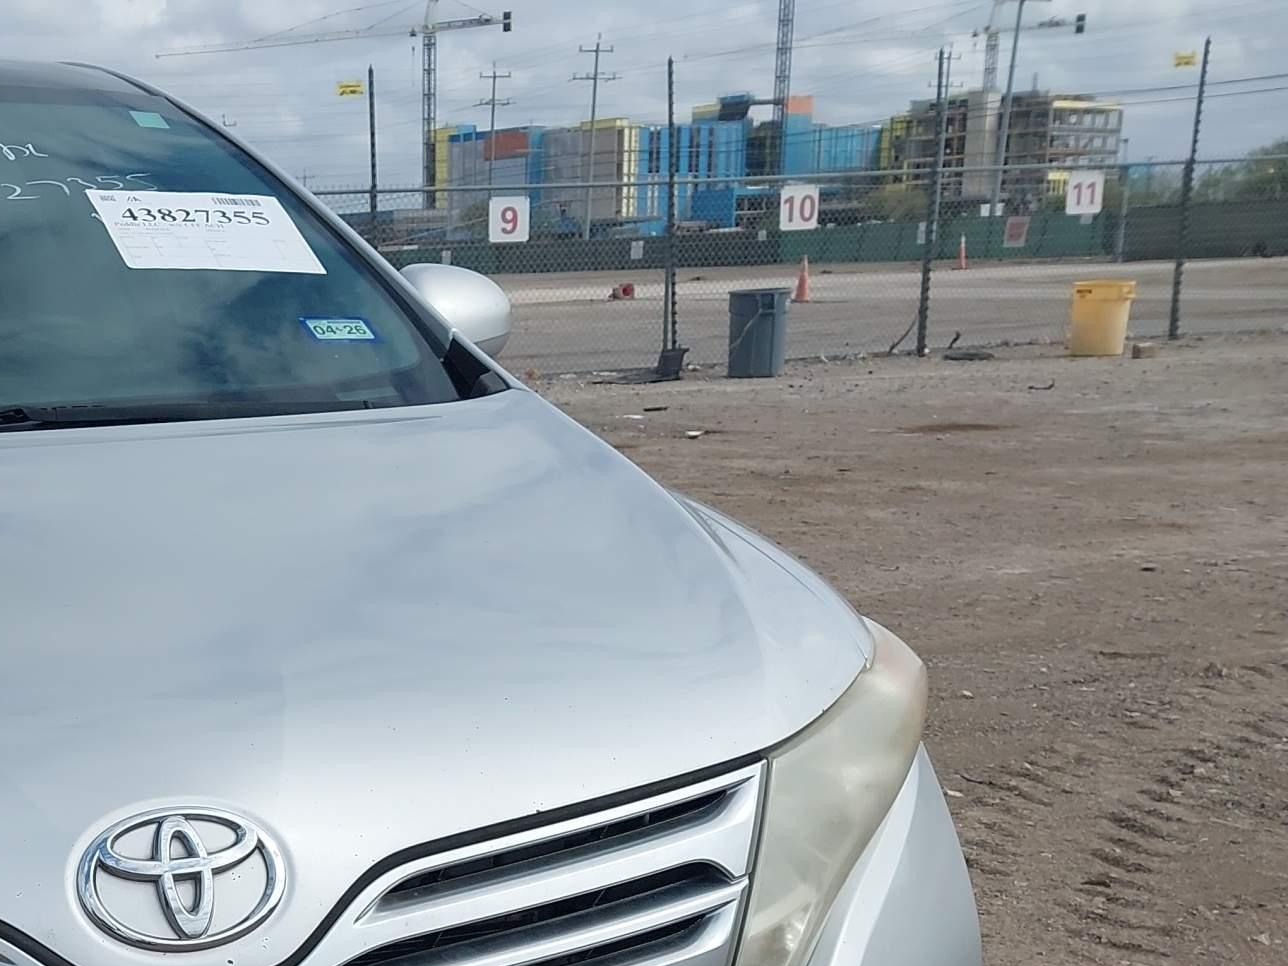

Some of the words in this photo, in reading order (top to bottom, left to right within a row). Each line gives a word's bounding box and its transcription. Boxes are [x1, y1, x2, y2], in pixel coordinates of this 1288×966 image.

[1073, 182, 1097, 206] 11
[121, 207, 270, 226] 43827355
[501, 206, 518, 235] 9
[783, 194, 816, 223] 10
